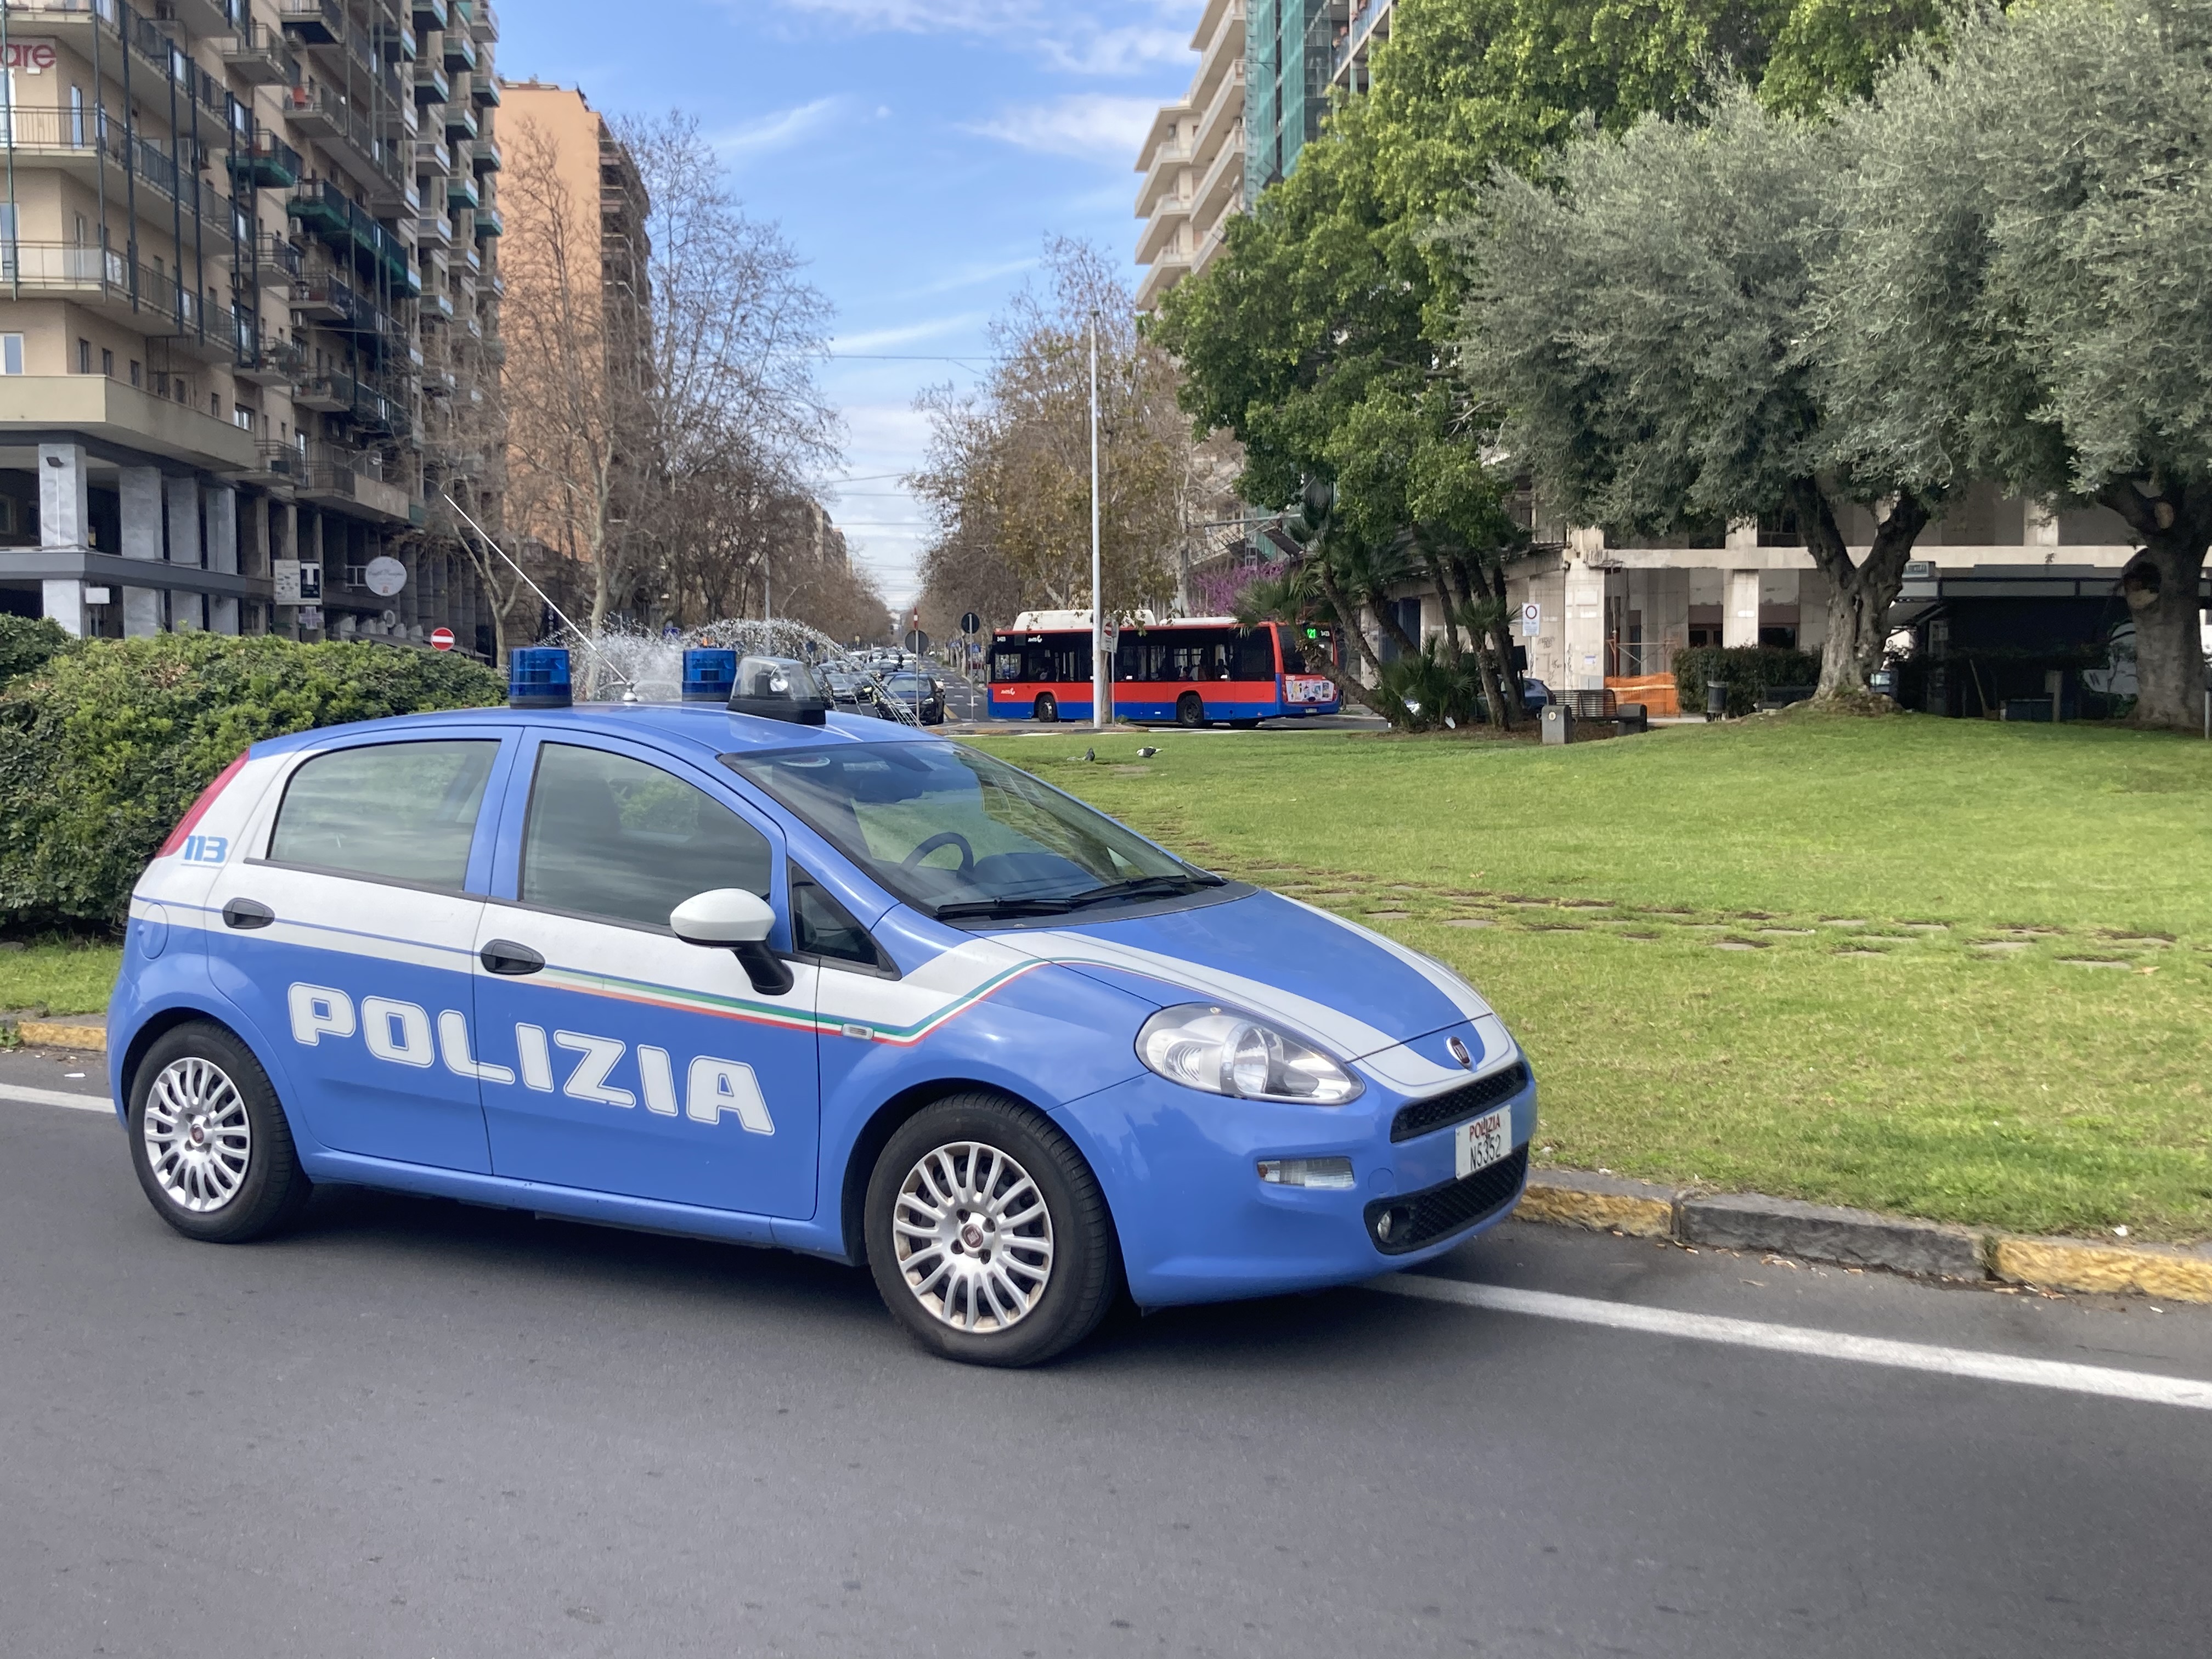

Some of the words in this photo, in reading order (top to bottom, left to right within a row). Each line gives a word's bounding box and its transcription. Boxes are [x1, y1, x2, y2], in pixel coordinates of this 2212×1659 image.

[184, 835, 228, 864] 113
[288, 981, 775, 1136] POLIZIA
[1469, 1113, 1501, 1142] POLIZIA
[1470, 1133, 1502, 1171] N5352
